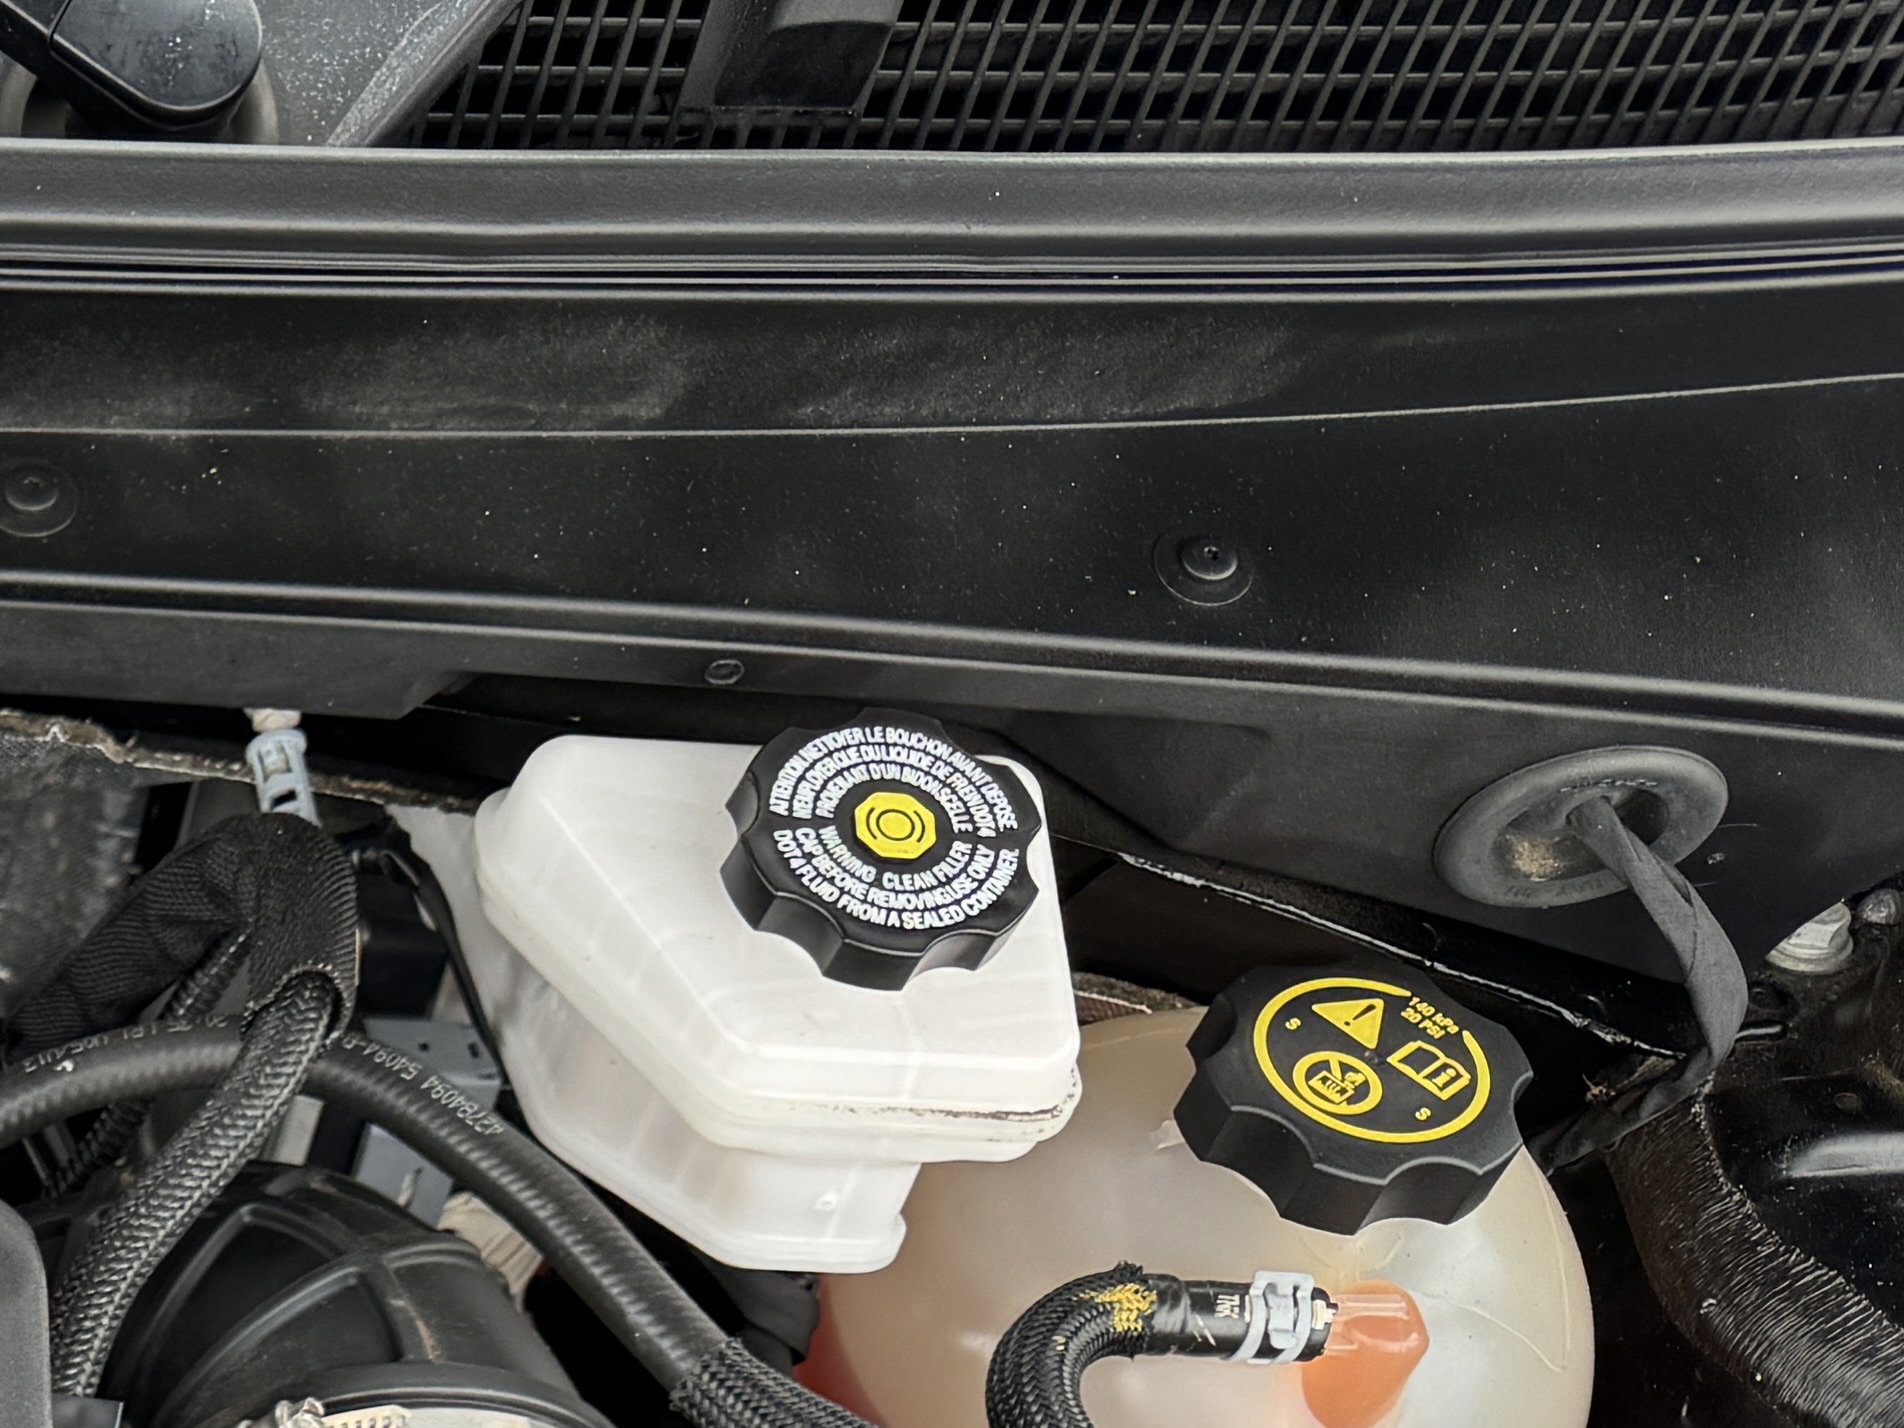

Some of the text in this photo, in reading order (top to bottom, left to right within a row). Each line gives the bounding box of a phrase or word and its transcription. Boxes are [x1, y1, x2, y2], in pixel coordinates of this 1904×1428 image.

[865, 726, 885, 743] LE
[886, 727, 953, 760] BOUCHON
[947, 751, 993, 788] AVANT
[930, 759, 954, 781] DE
[795, 827, 824, 855] CAP
[811, 853, 870, 900] BEFORE
[967, 844, 995, 879] ONLY
[818, 825, 972, 891] WARNING CLEAN FILLER
[795, 864, 840, 902] FLUID
[837, 894, 887, 925] FROM
[887, 911, 900, 927] A
[901, 905, 965, 929] SEALED
